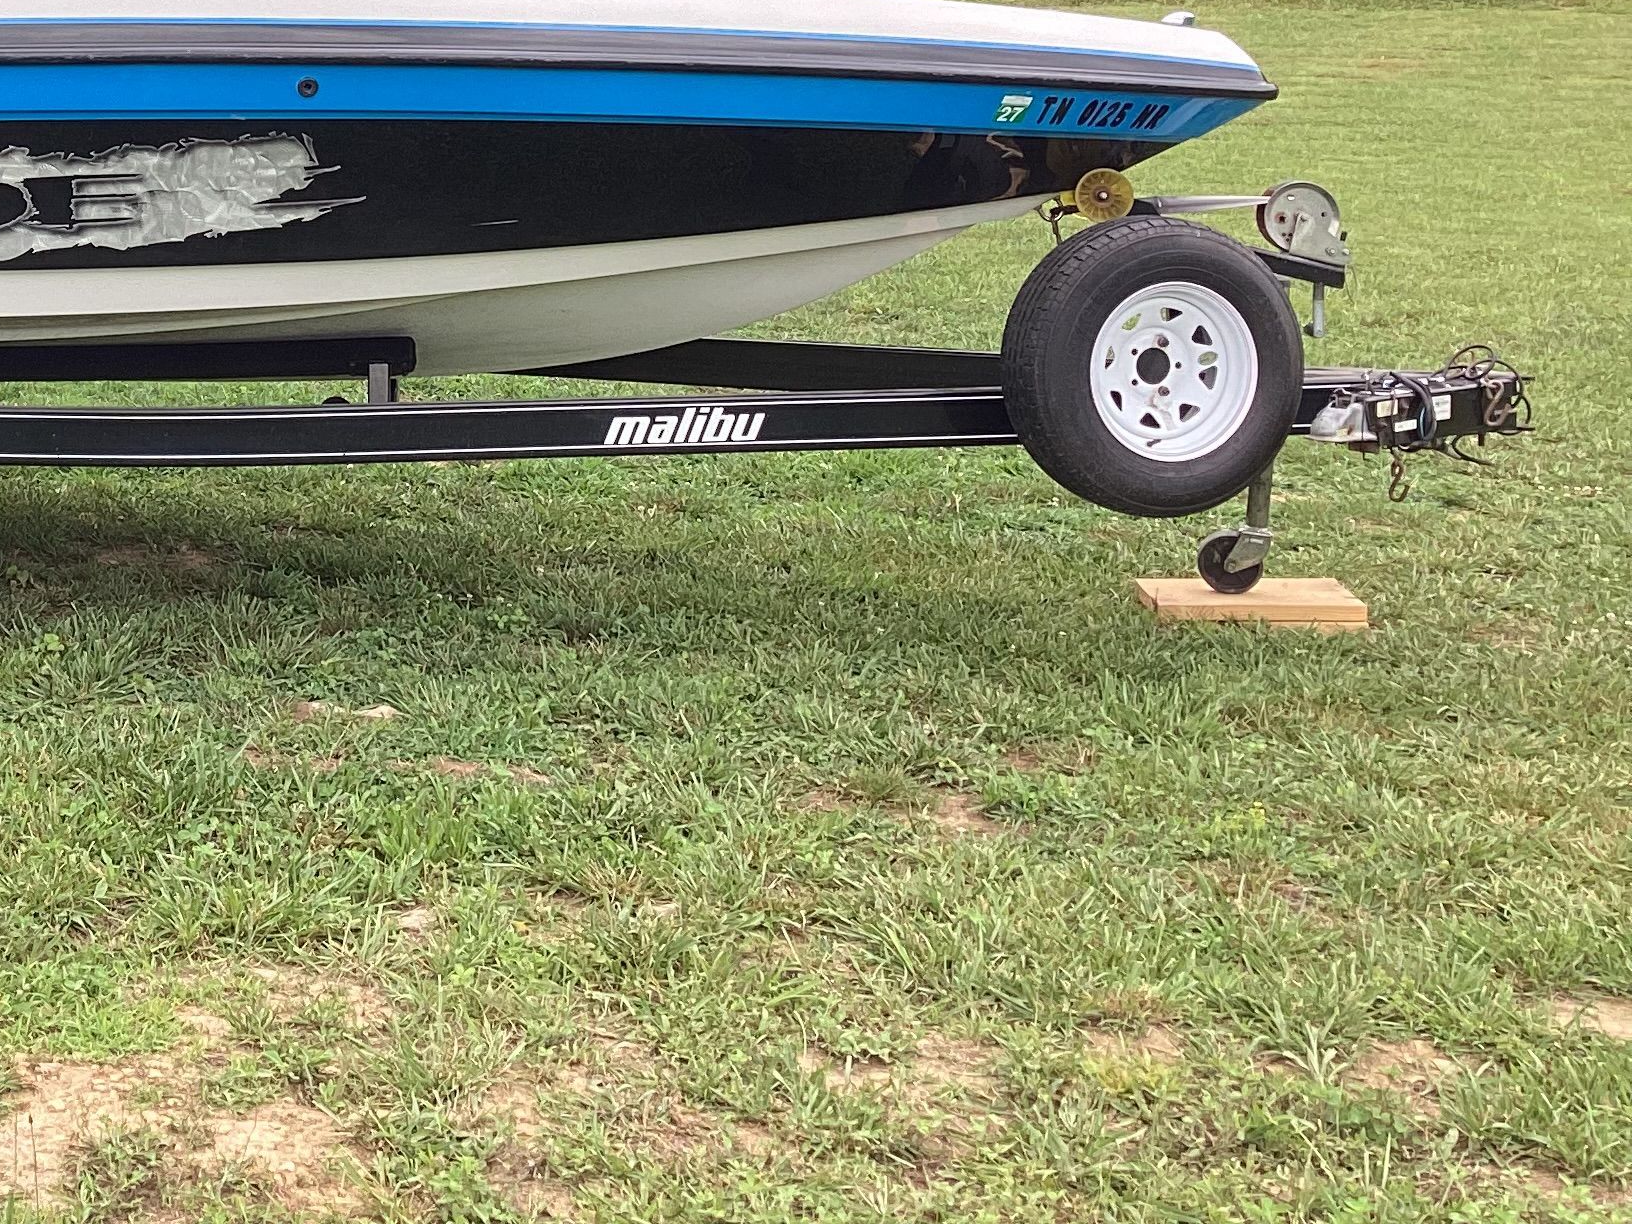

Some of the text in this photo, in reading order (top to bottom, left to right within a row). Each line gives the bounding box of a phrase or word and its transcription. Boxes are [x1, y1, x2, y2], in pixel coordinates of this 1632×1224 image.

[996, 106, 1025, 122] 27
[1036, 96, 1075, 125] TN
[1077, 99, 1134, 127] 0125
[603, 407, 766, 445] malibu
